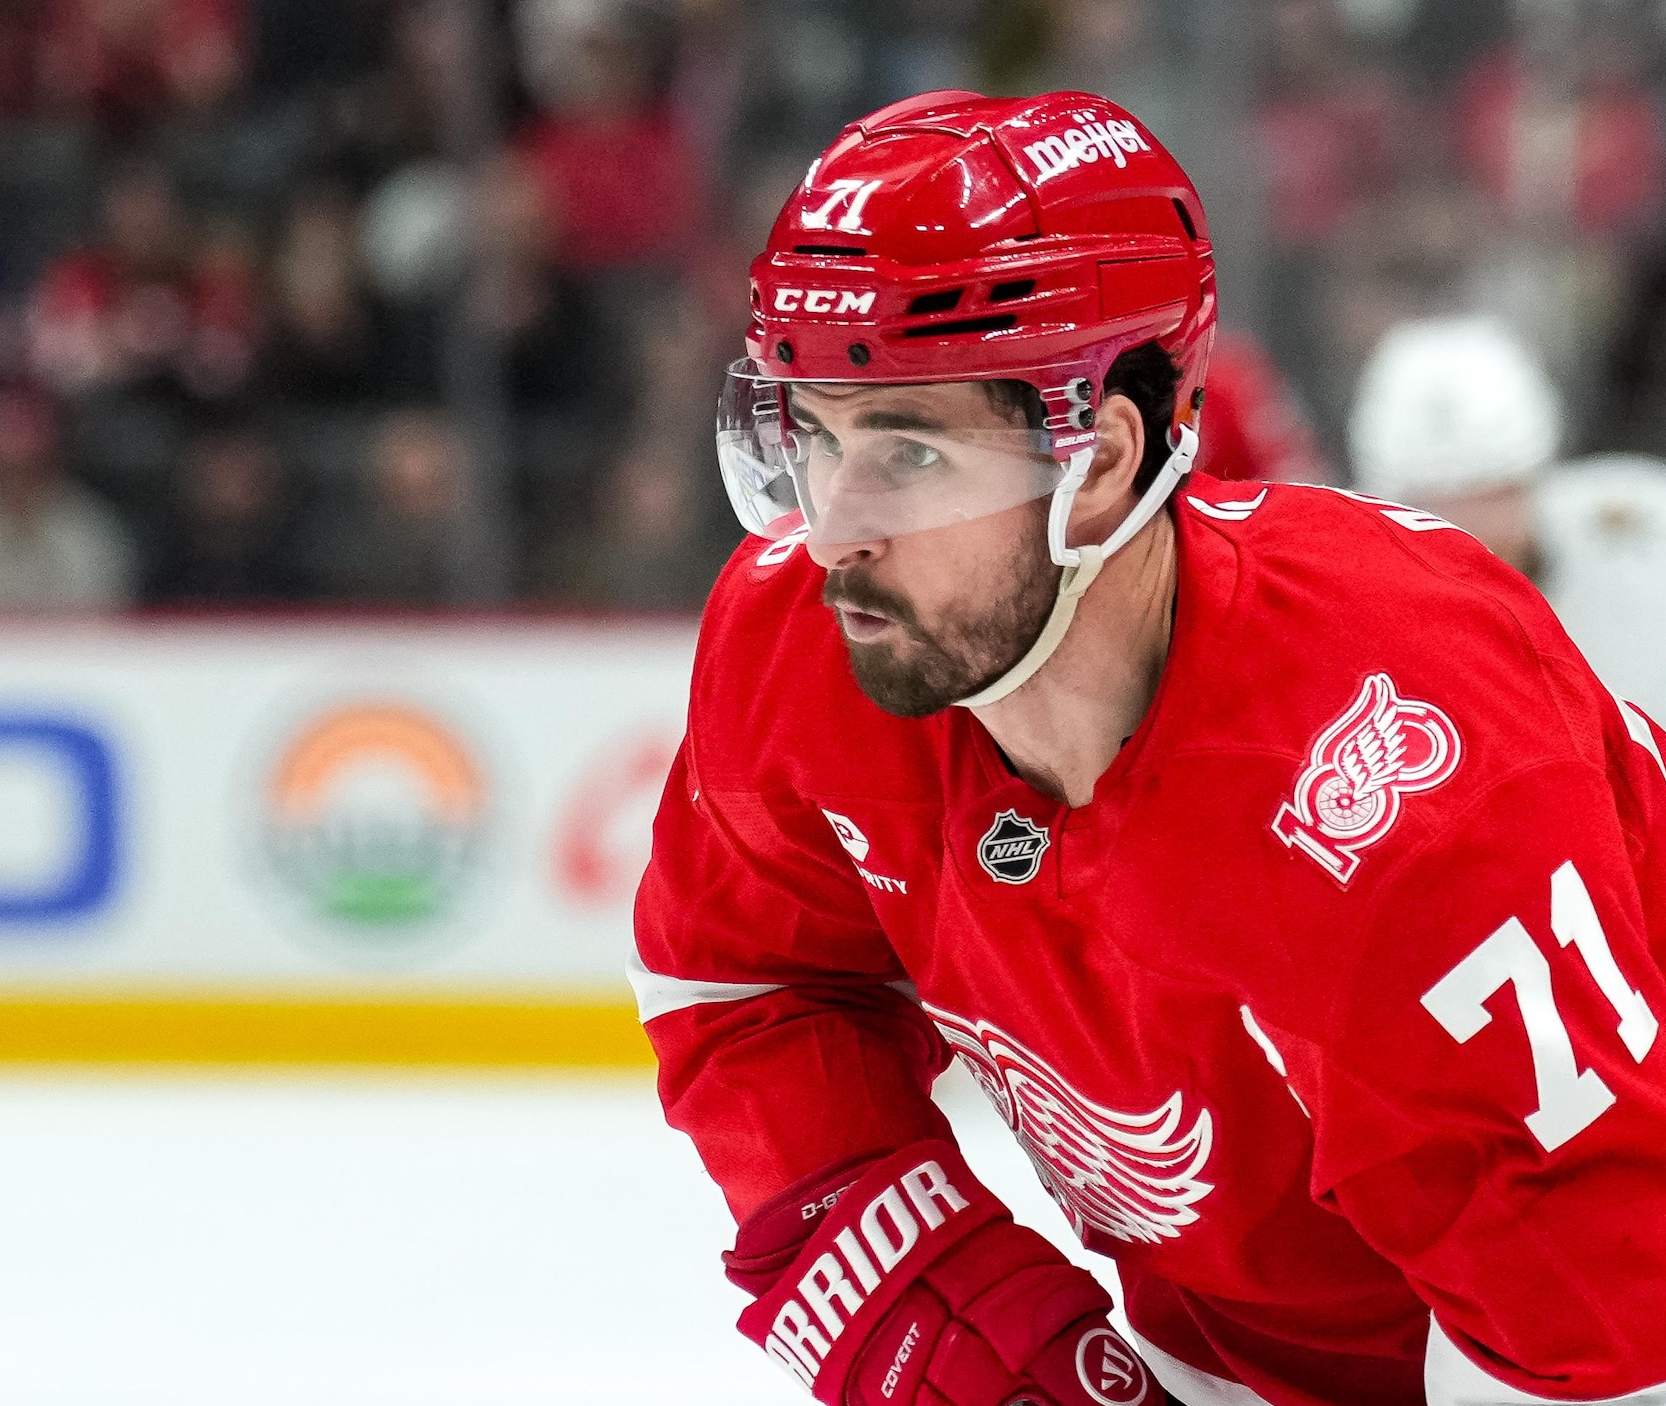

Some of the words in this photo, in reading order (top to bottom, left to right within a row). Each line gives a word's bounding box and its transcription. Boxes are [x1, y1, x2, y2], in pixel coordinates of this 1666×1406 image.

[1022, 111, 1152, 172] meijer
[800, 179, 883, 231] 71
[774, 288, 876, 314] CCM
[988, 840, 1035, 860] NHL
[853, 860, 908, 895] RITY
[1420, 860, 1659, 1153] 71
[881, 1322, 920, 1399] COVERT
